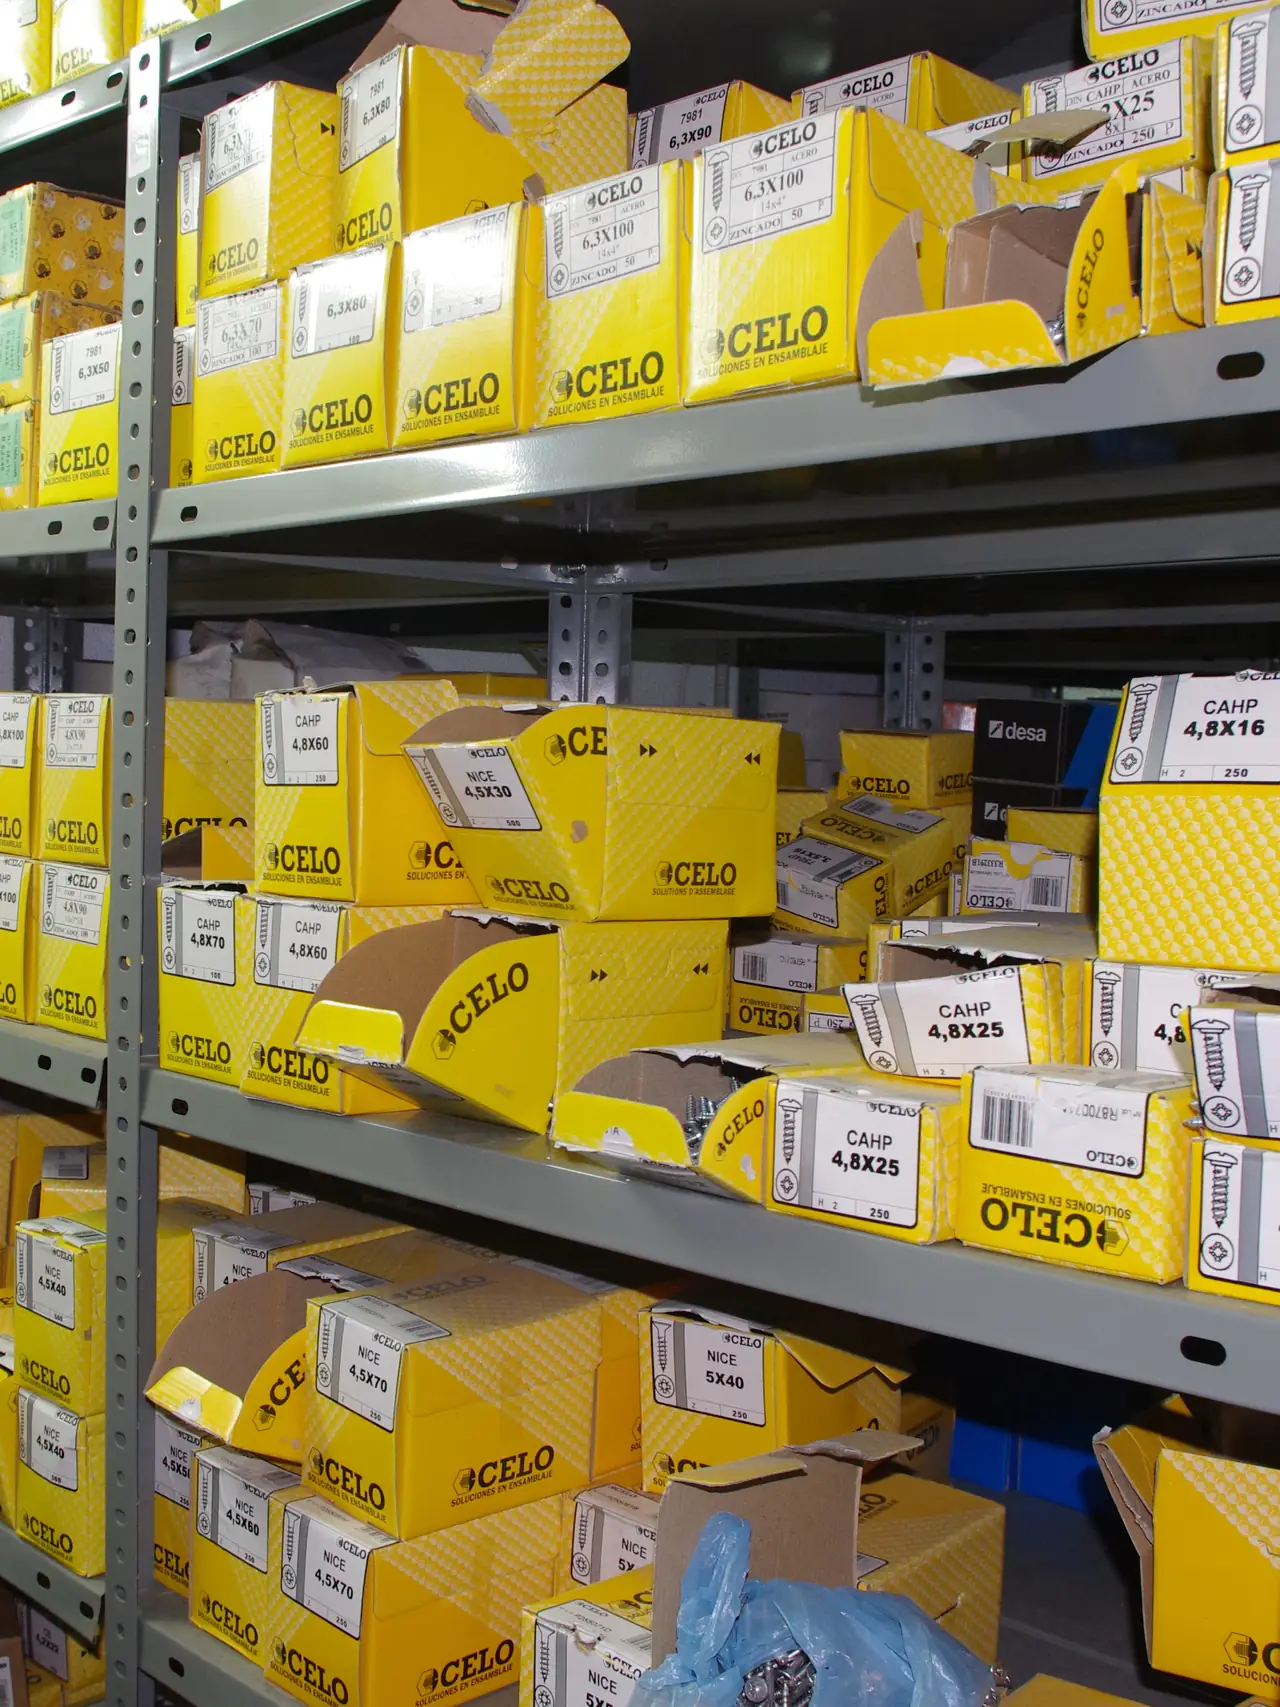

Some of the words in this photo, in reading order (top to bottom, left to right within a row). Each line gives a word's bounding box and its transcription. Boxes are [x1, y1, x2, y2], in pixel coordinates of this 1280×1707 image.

[1100, 50, 1160, 80] CELO
[370, 80, 384, 97] 7981
[852, 72, 894, 96] CELO
[1086, 84, 1120, 104] CAHP
[1131, 70, 1170, 88] ACERO
[700, 89, 726, 104] CELO
[362, 97, 390, 126] 6,3X80
[680, 109, 702, 124] 7981
[975, 114, 1008, 131] CELO
[669, 125, 712, 149] 6,3X90
[765, 122, 816, 154] CELO
[1065, 139, 1124, 162] ZINCADO
[1132, 128, 1154, 144] 250
[1166, 122, 1174, 135] P
[790, 148, 818, 162] ACERO
[598, 176, 643, 206] CELO
[621, 200, 645, 214] ACERO
[346, 202, 393, 242] CELO
[729, 217, 780, 242] ZINCADO
[791, 208, 802, 221] 50
[583, 220, 634, 250] 6,3X100
[213, 238, 259, 273] CELO
[572, 265, 616, 286] ZINCADO
[625, 256, 635, 268] 50
[1077, 228, 1104, 308] CELO
[328, 296, 366, 318] 6,3X80
[728, 305, 828, 358] CELO
[249, 346, 262, 358] 100
[696, 357, 750, 380] SOLUCIONES
[754, 354, 764, 368] EN
[767, 342, 828, 366] ENSAMBLAJE
[78, 361, 110, 380] 6,3X50
[576, 350, 664, 398] CELO
[424, 372, 500, 414] CELO
[548, 400, 597, 417] SOLUCIONES
[600, 397, 610, 408] EN
[612, 385, 664, 406] ENSAMBLAJE
[309, 394, 372, 433] CELO
[402, 416, 442, 432] SOLUCIONES
[444, 414, 452, 424] EN
[455, 404, 500, 422] ENSAMBLAJE
[220, 430, 276, 460] CELO
[290, 431, 325, 449] SOLUCIONES
[326, 432, 334, 442] EN
[334, 424, 374, 441] ENSAMBLAJE
[60, 442, 110, 474] CELO
[204, 458, 232, 472] SOLUCIONES
[240, 454, 276, 466] ENSAMBLAJE
[72, 701, 94, 714] CELO
[1204, 698, 1259, 715] CAHP
[296, 714, 322, 728] CAHP
[1005, 722, 1046, 742] desa
[1184, 720, 1266, 741] 4,8X16
[292, 736, 329, 754] 4,8X60
[477, 748, 506, 758] CELO
[316, 774, 326, 782] 250
[466, 770, 496, 783] NICE
[1180, 770, 1186, 778] 2
[1224, 768, 1248, 778] 250
[464, 786, 512, 800] 4,5X30
[863, 776, 910, 794] CELO
[57, 820, 98, 844] CELO
[281, 845, 340, 875] CELO
[73, 874, 98, 890] CELO
[263, 872, 296, 882] SOLUCIONES
[297, 875, 304, 883] EN
[306, 874, 342, 886] ENSAMBLAJE
[406, 871, 452, 880] SOLUCIONES
[454, 870, 464, 880] EN
[674, 862, 737, 886] CELO
[914, 861, 952, 896] CELO
[504, 879, 569, 902] CELO
[652, 888, 687, 896] SOLUTIONS
[690, 888, 736, 896] D'ASSEMBLAGE
[970, 894, 1006, 909] CELO
[212, 898, 232, 909] CELO
[198, 918, 220, 931] CAHP
[296, 921, 321, 935] CAHP
[190, 932, 225, 950] 4,8X70
[290, 943, 328, 961] 4,8X60
[788, 980, 808, 990] CELO
[54, 988, 96, 1018] CELO
[450, 962, 529, 1034] CELO
[740, 1009, 791, 1030] CELO
[940, 1002, 991, 1018] CAHP
[826, 1018, 843, 1029] 250
[928, 1022, 1004, 1042] 4,8X25
[182, 1034, 230, 1064] CELO
[167, 1054, 194, 1067] SOLUCIONES
[202, 1060, 232, 1074] ENSAMBLAJE
[267, 1046, 329, 1084] CELO
[940, 1068, 946, 1076] 2
[248, 1071, 282, 1087] SOLUCIONES
[284, 1078, 291, 1087] EN
[292, 1079, 330, 1096] ENSAMBLAJE
[723, 1099, 764, 1146] CELO
[847, 1130, 892, 1152] CAHP
[832, 1150, 900, 1177] 4,8X25
[1086, 1148, 1126, 1168] CELO
[982, 1182, 1046, 1205] ENSAMBLAJE
[1048, 1189, 1062, 1206] EN
[818, 1198, 824, 1207] H
[832, 1201, 838, 1210] 2
[870, 1207, 890, 1220] 250
[1066, 1198, 1132, 1220] SOLUCIONES
[981, 1198, 1092, 1248] CELO
[246, 1248, 266, 1260] CELO
[45, 1264, 61, 1280] NICE
[232, 1264, 252, 1278] NICE
[1260, 1271, 1268, 1281] H
[38, 1276, 66, 1296] 4,5X40
[378, 1332, 401, 1352] CELO
[730, 1334, 762, 1349] CELO
[358, 1345, 380, 1366] NICE
[707, 1349, 738, 1368] NICE
[30, 1360, 70, 1396] CELO
[349, 1363, 388, 1394] 4,5X70
[706, 1370, 744, 1390] 5X40
[59, 1411, 78, 1426] CELO
[370, 1410, 382, 1422] 250
[732, 1410, 748, 1420] 250
[44, 1425, 60, 1442] NICE
[36, 1435, 65, 1460] 4,5X40
[170, 1445, 188, 1463] NICE
[478, 1446, 554, 1490] CELO
[326, 1456, 385, 1510] CELO
[451, 1488, 495, 1508] SOLUCIONES
[497, 1482, 507, 1494] EN
[508, 1470, 553, 1492] ENSAMBLAJE
[235, 1498, 254, 1518] NICE
[308, 1472, 340, 1498] SOLUCIONES
[350, 1498, 388, 1524] ENSAMBLAJE
[226, 1507, 260, 1537] 4,5X60
[30, 1516, 73, 1554] CELO
[244, 1553, 256, 1564] 250
[343, 1540, 366, 1560] CELO
[622, 1537, 648, 1560] NICE
[323, 1550, 346, 1572] NICE
[314, 1568, 354, 1600] 4,5X70
[212, 1600, 259, 1646] CELO
[336, 1616, 348, 1628] 250
[440, 1639, 514, 1685] CELO
[270, 1662, 303, 1688] SOLUCIONES
[288, 1646, 348, 1705] CELO
[415, 1686, 458, 1707] SOLUCIONES
[460, 1680, 470, 1691] EN
[470, 1663, 513, 1688] ENSAMBLAJE
[588, 1670, 618, 1696] NICE
